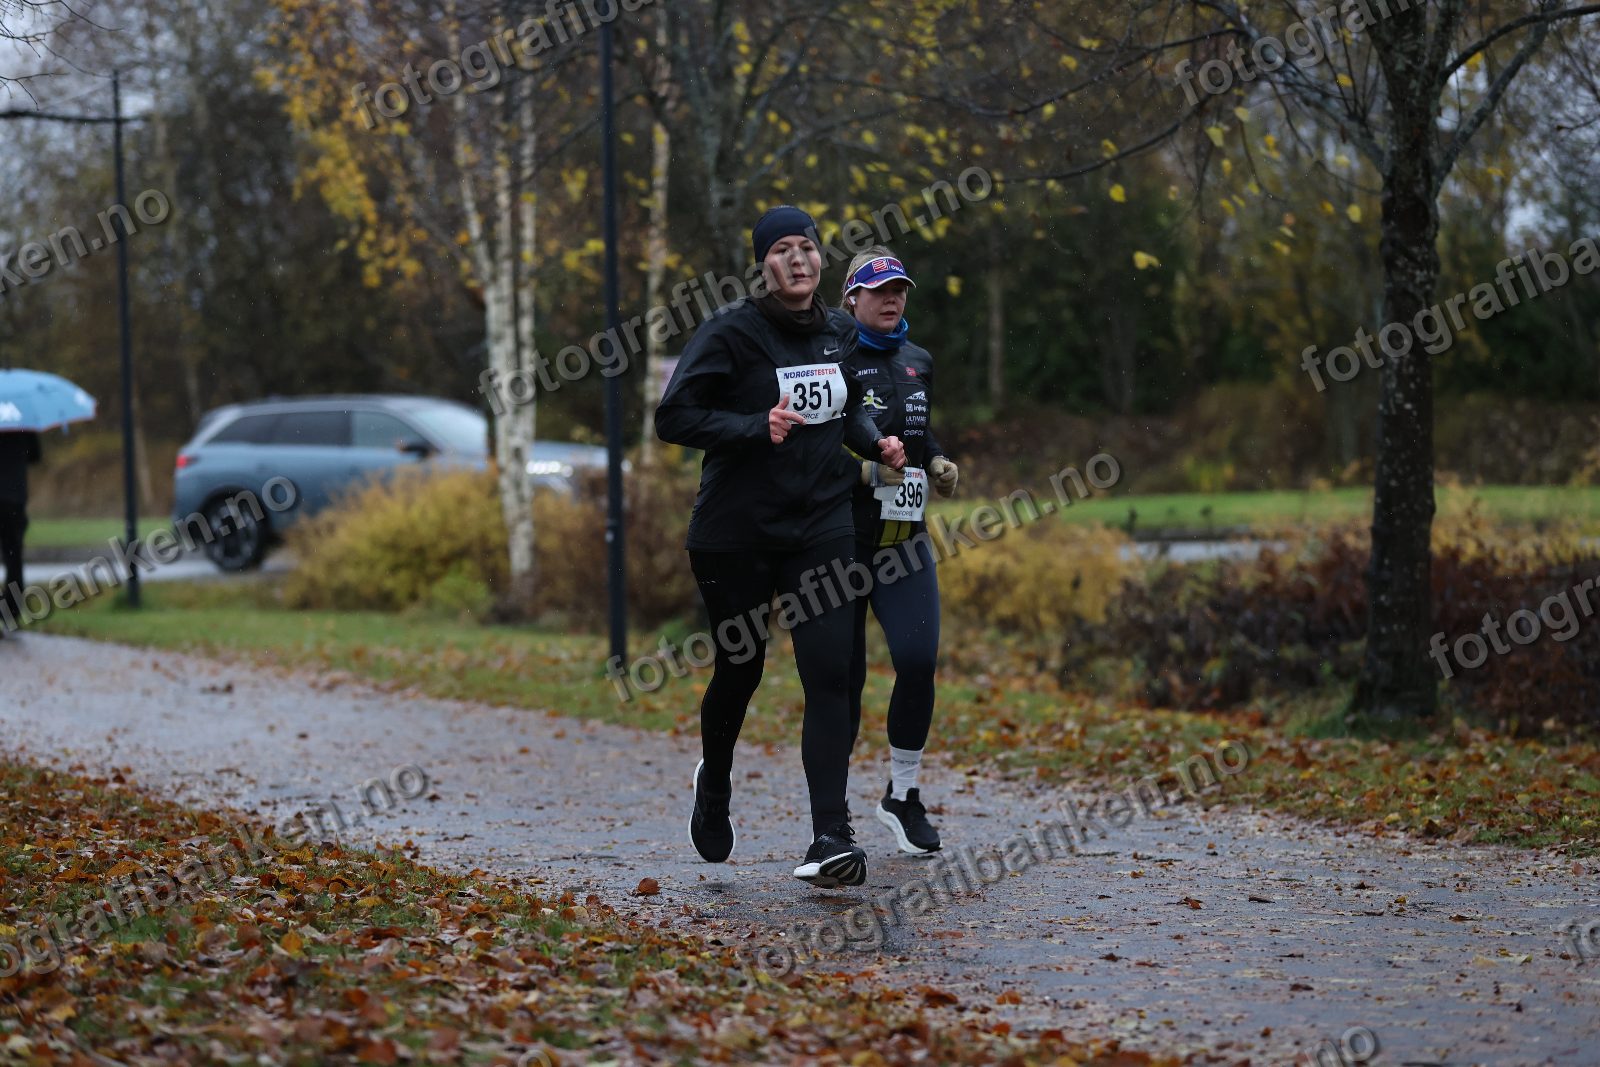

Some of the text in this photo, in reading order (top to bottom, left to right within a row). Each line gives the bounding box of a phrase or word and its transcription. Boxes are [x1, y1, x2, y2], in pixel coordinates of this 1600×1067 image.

[783, 367, 837, 380] NORGESTESTEN
[792, 379, 832, 412] 351
[894, 481, 923, 508] 396
